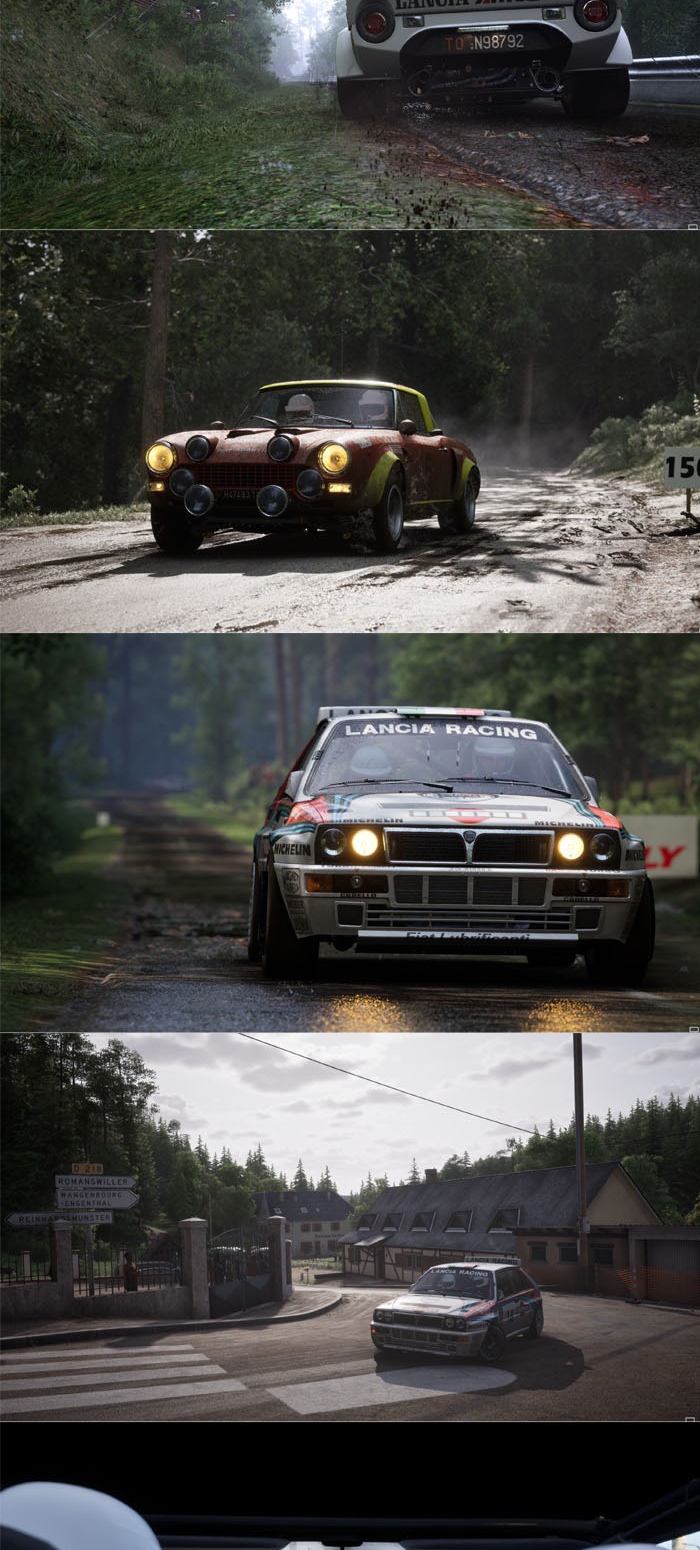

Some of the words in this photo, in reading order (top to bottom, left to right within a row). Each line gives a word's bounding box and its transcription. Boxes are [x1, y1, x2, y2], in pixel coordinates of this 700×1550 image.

[474, 34, 524, 49] N98792
[666, 456, 700, 478] 15
[345, 724, 435, 736] LANCIA
[446, 724, 537, 740] RACING
[58, 1177, 128, 1186] ROMANSWILLER
